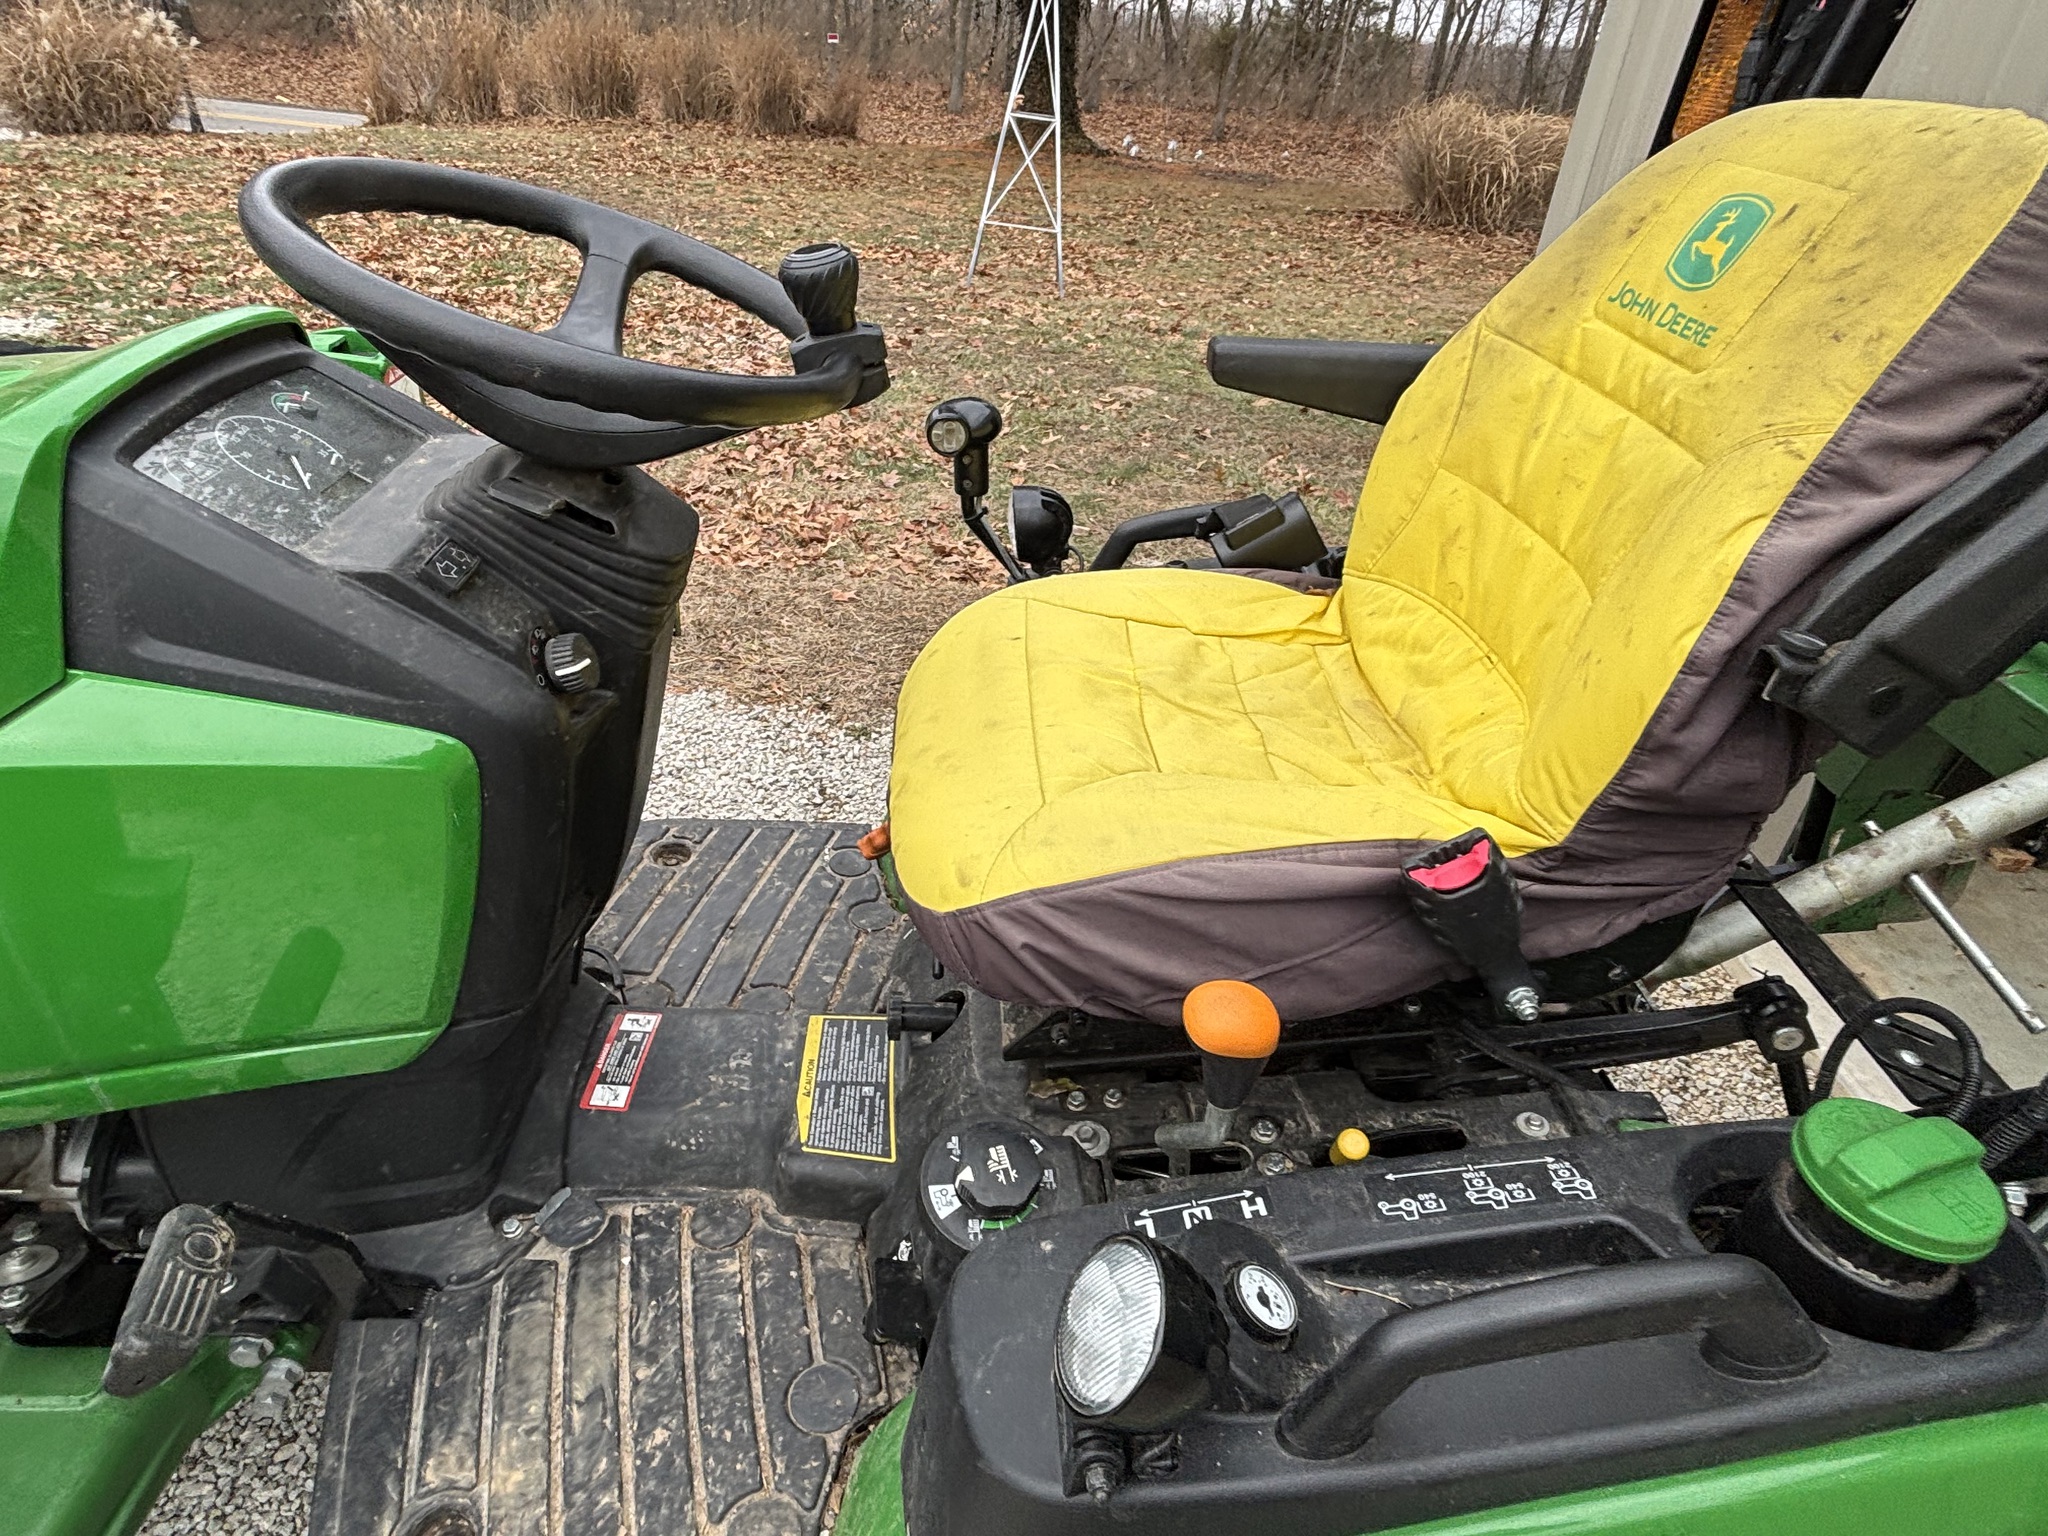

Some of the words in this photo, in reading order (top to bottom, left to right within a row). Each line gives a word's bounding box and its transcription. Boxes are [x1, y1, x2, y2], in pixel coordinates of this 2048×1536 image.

[1607, 280, 1661, 322] JOHN
[1655, 302, 1719, 348] DEERE
[804, 1058, 816, 1091] CAUTION
[1240, 1196, 1268, 1219] H
[1134, 1217, 1156, 1239] L
